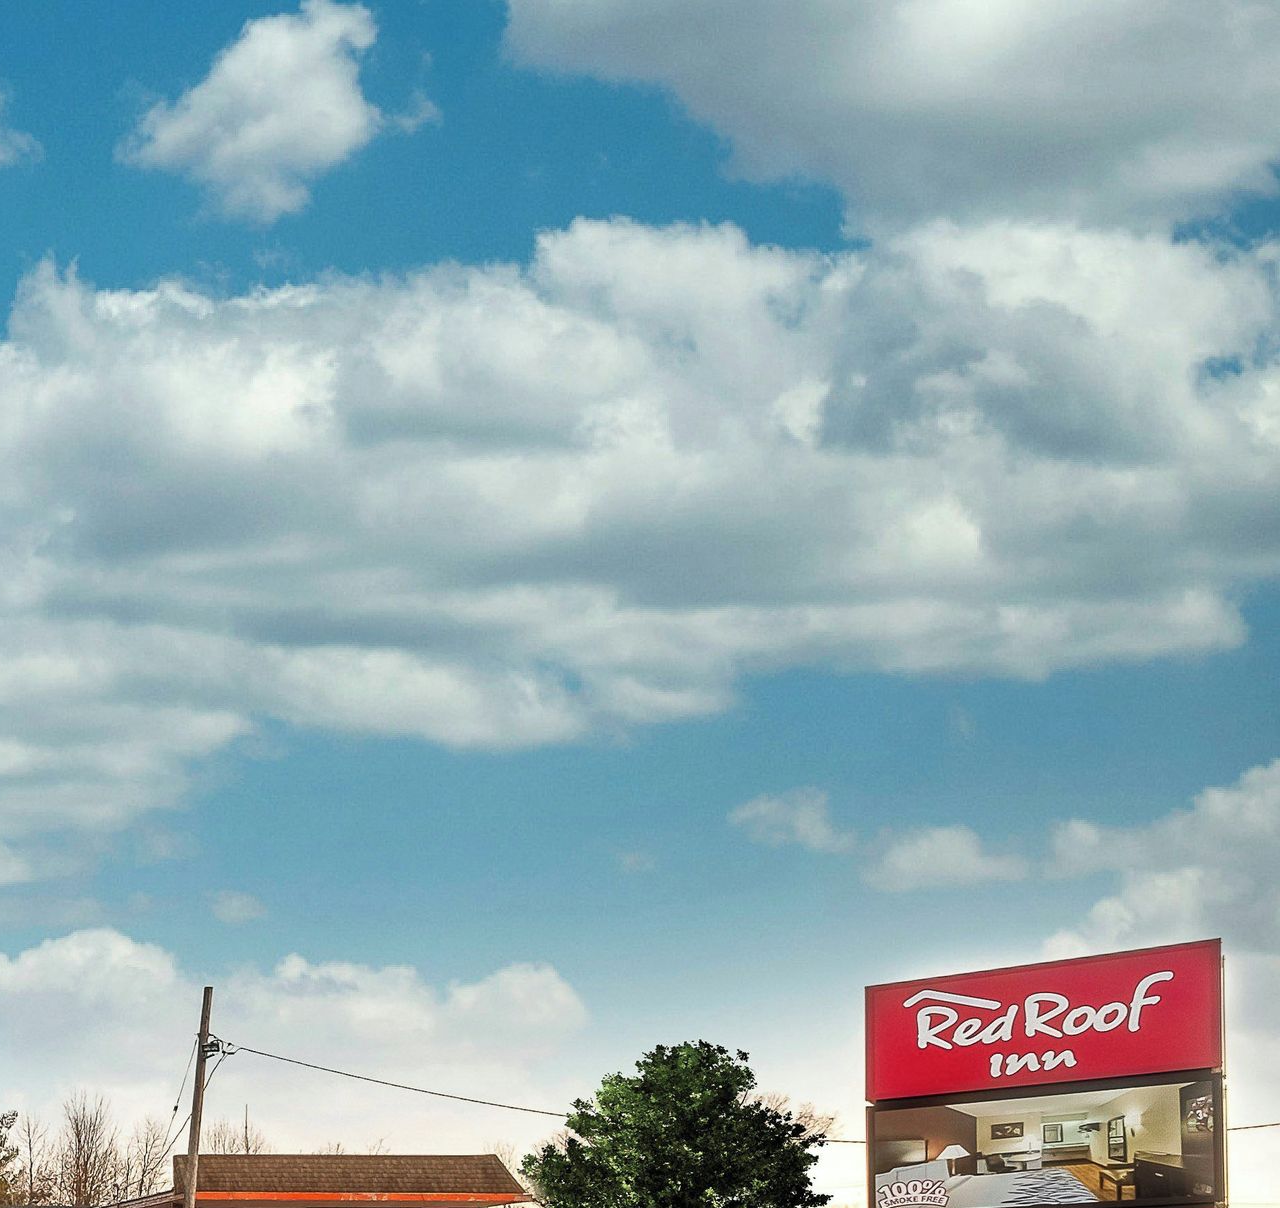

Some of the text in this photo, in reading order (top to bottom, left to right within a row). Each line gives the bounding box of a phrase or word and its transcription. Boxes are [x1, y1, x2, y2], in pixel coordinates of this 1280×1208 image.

[917, 971, 1174, 1050] Red Roof
[877, 1180, 947, 1199] 100%
[883, 1195, 945, 1207] SMOKE FREE
